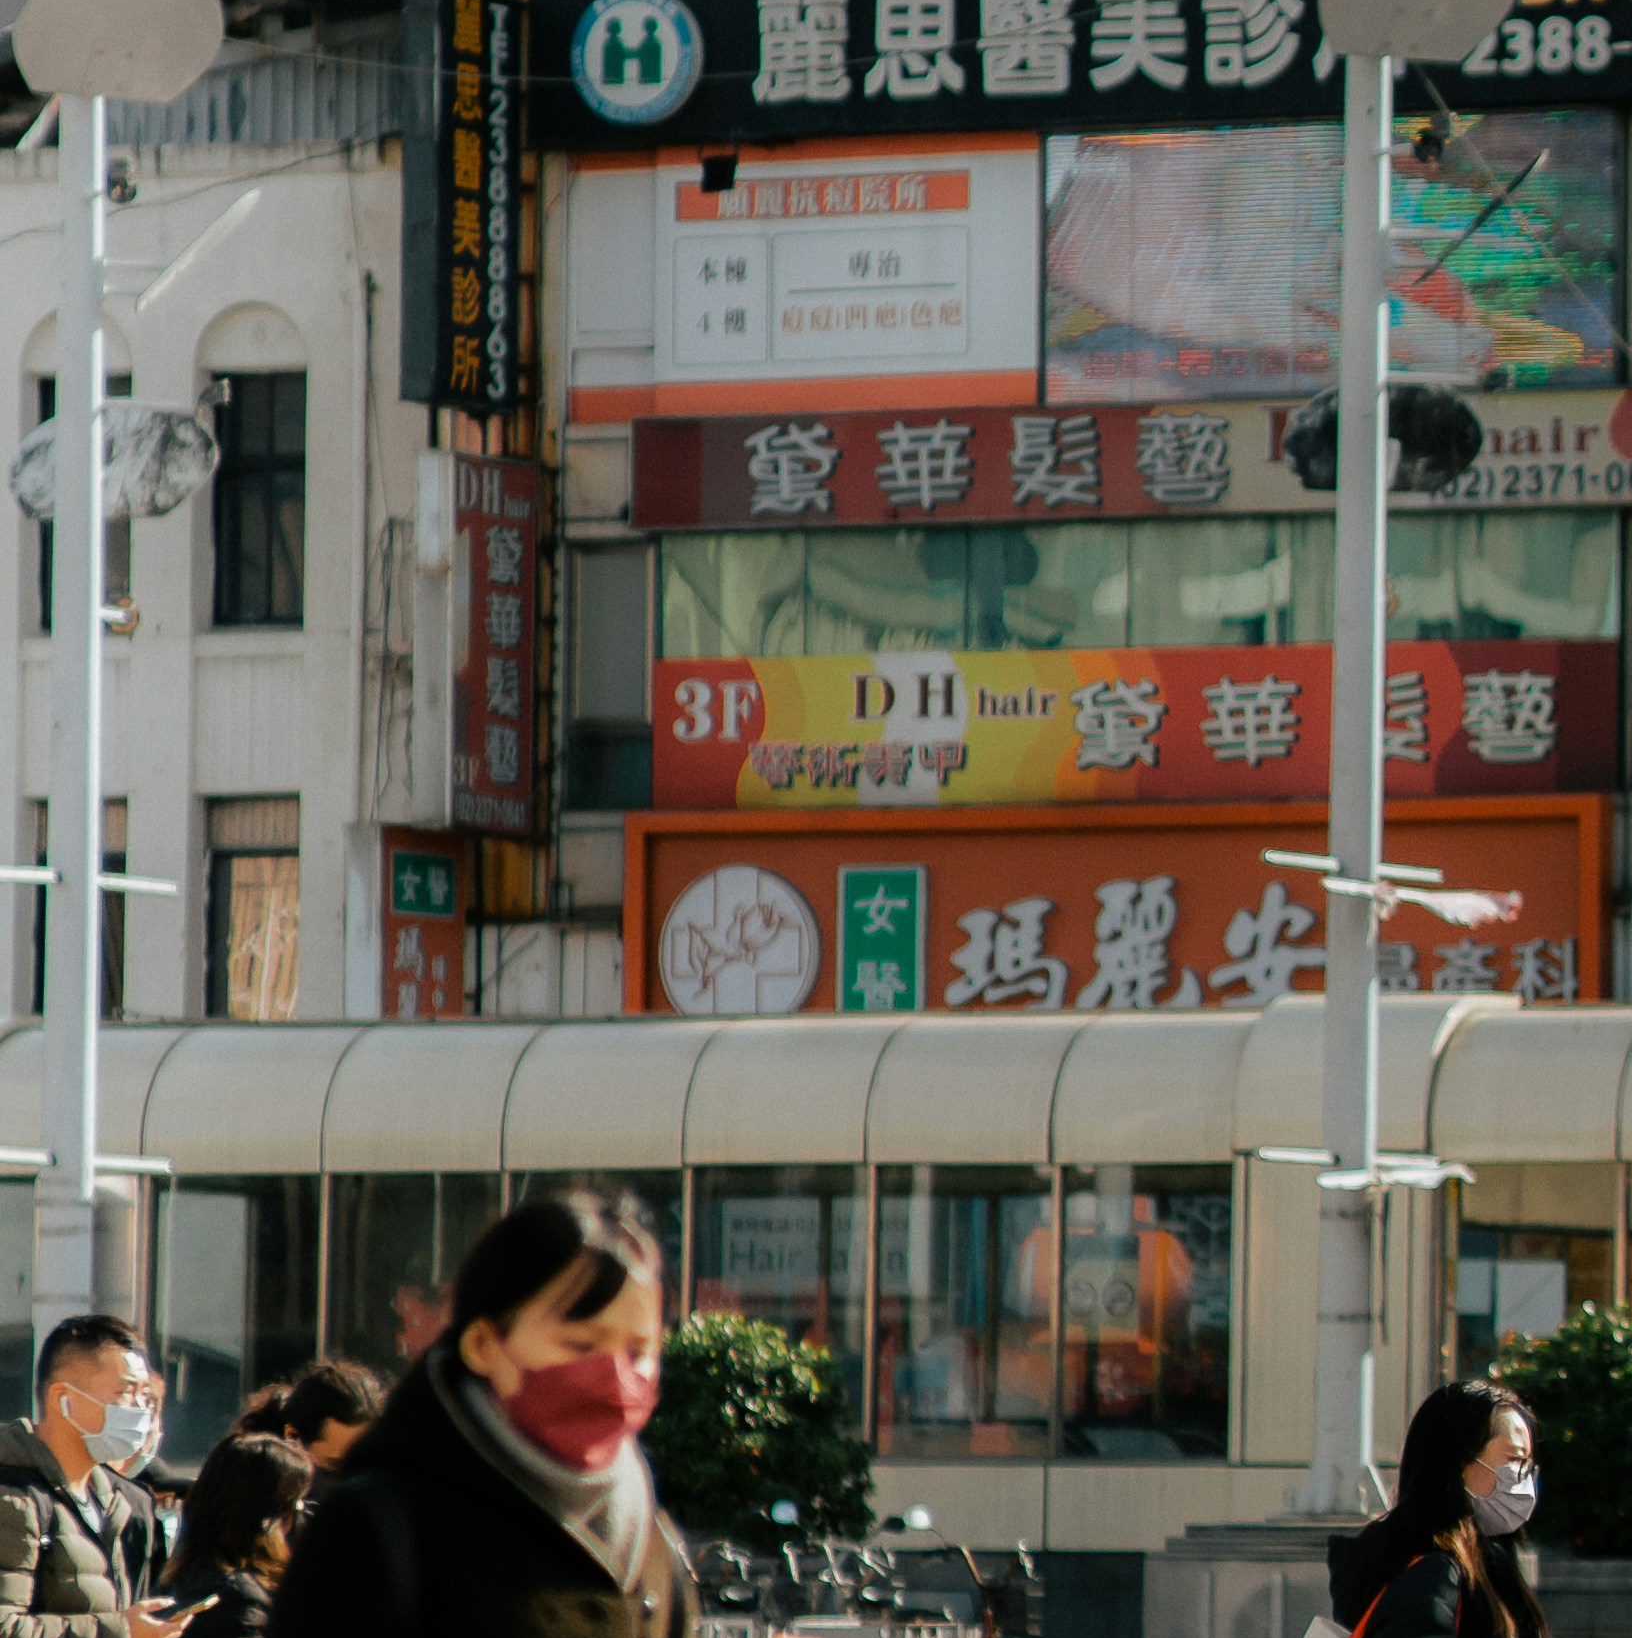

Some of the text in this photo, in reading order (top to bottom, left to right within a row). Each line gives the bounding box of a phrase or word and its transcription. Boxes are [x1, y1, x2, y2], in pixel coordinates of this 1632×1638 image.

[672, 678, 761, 743] 3F
[977, 686, 1060, 718] hair
[854, 885, 909, 1011] 女醫
